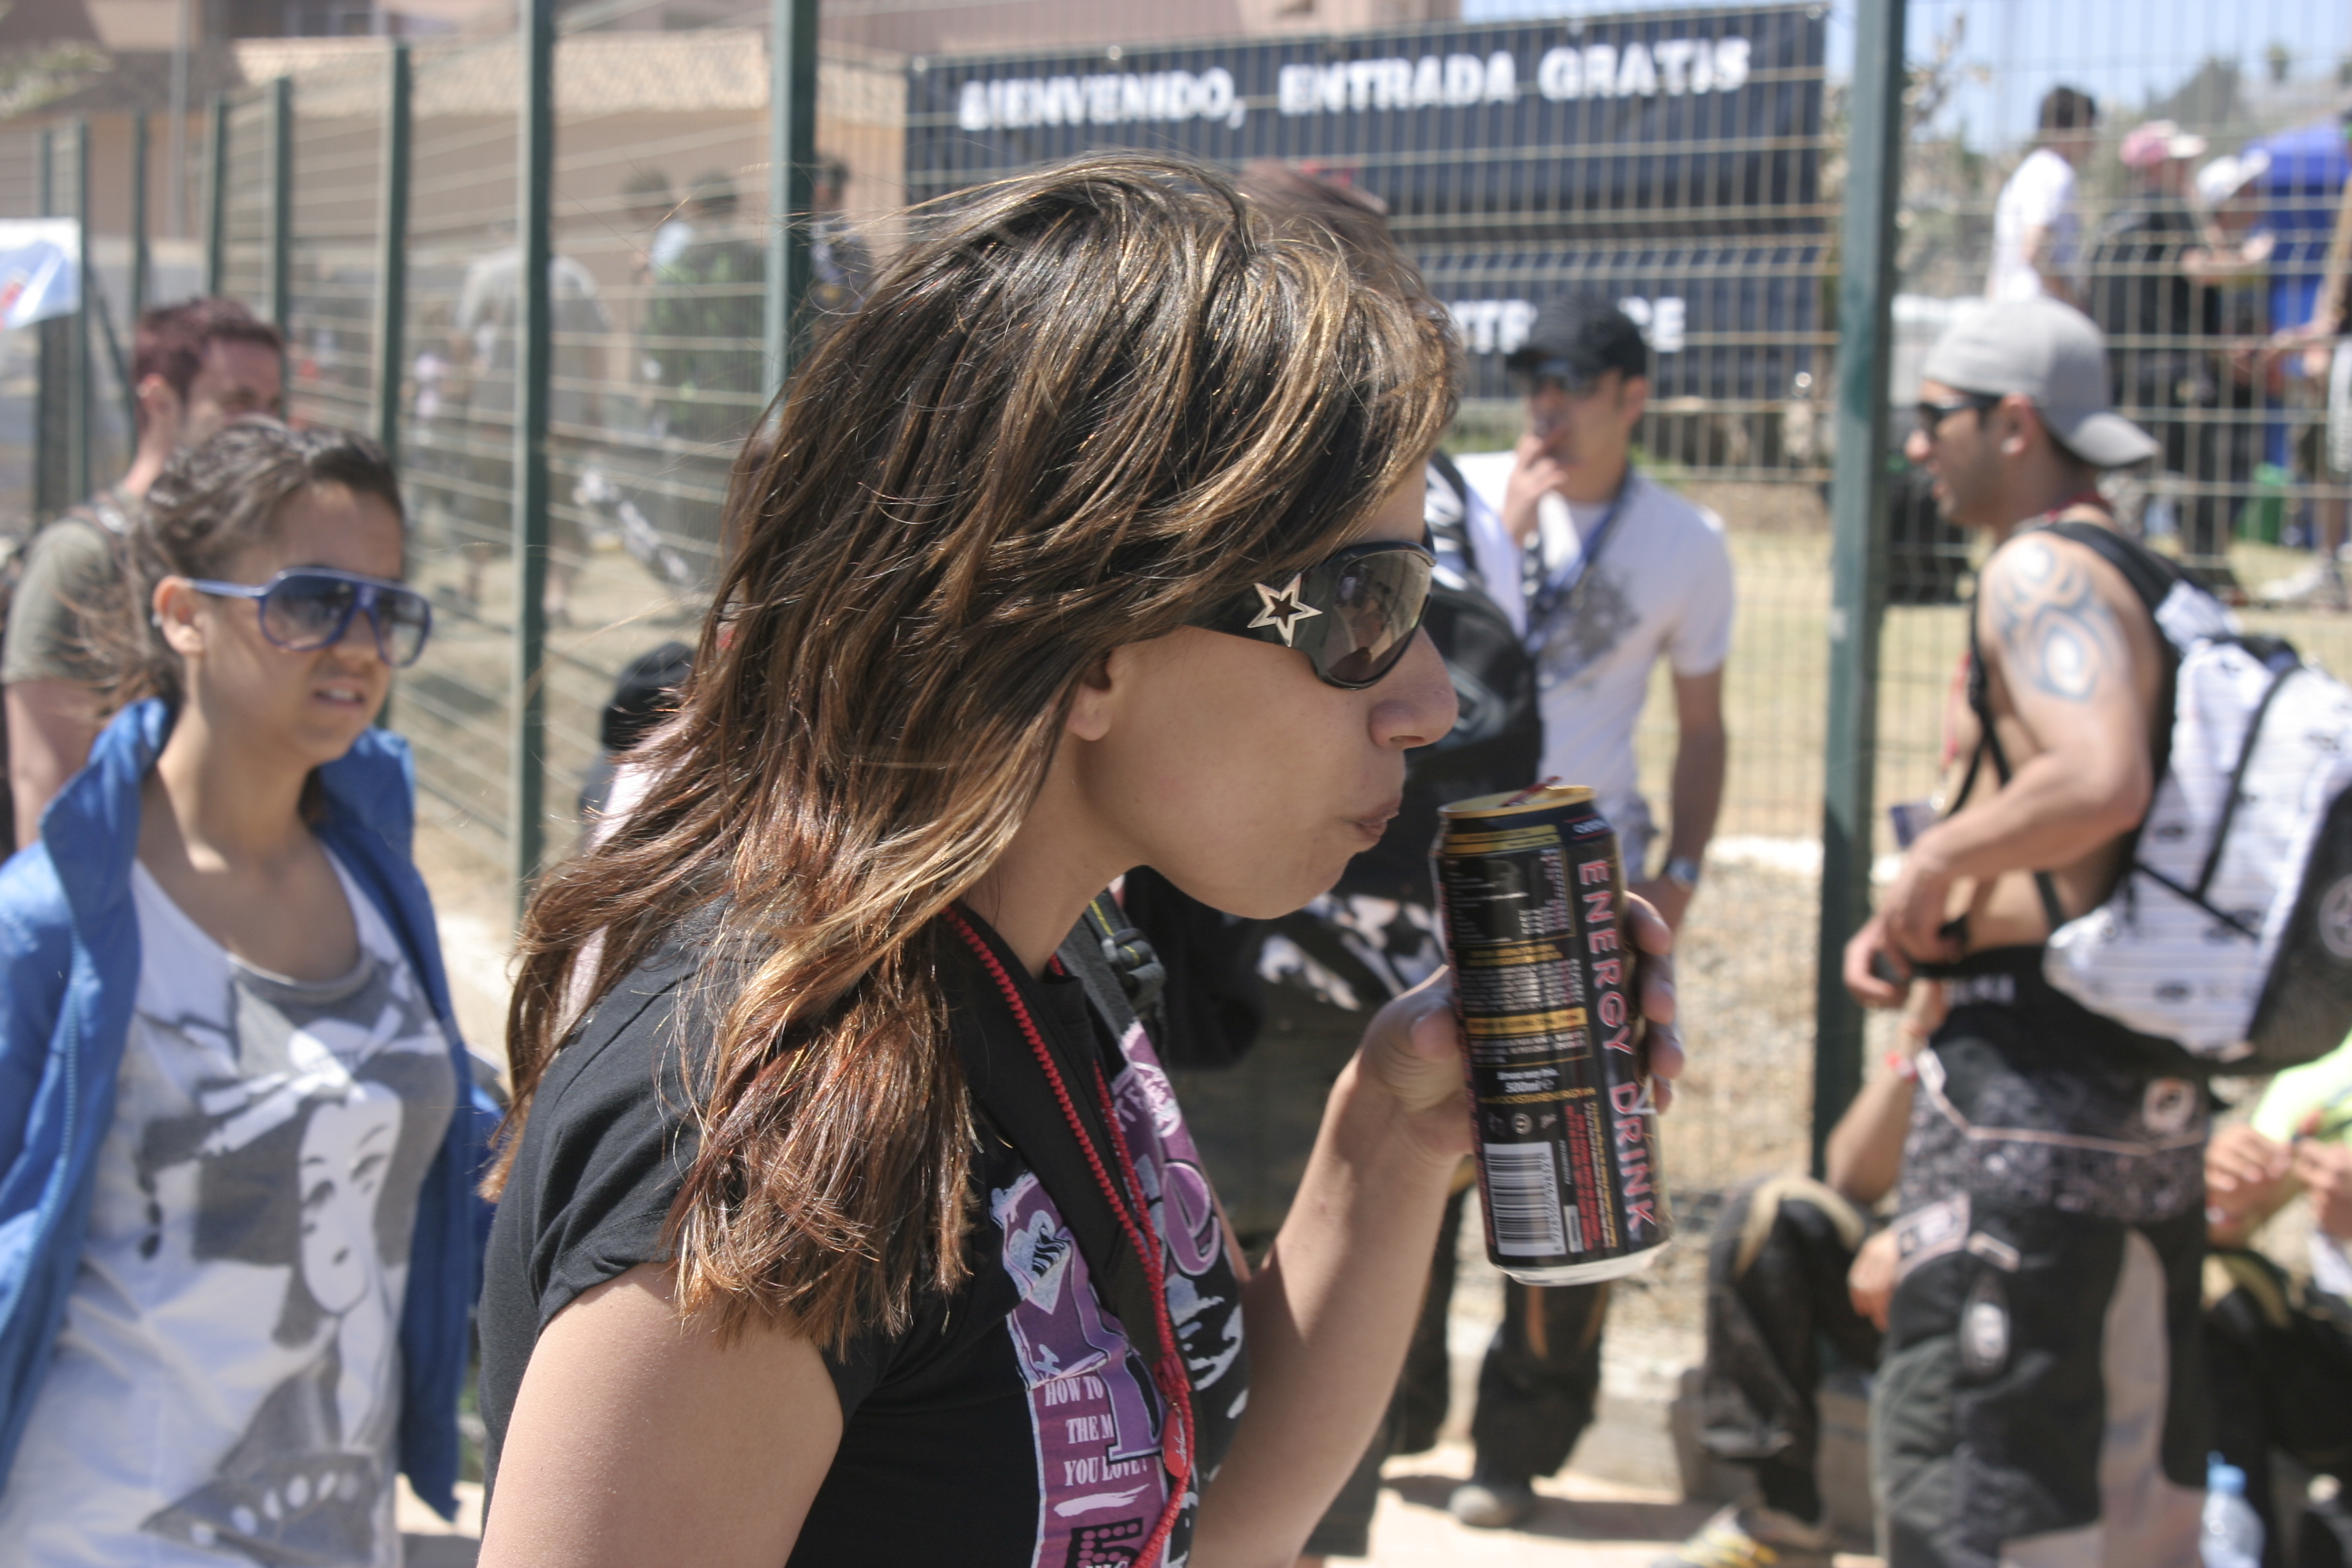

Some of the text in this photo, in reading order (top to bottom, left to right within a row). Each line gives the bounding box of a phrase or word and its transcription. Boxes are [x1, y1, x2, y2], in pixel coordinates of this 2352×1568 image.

[958, 36, 1751, 131] BIENVENIDO, ENTRADA GRATIS
[1578, 859, 1633, 1055] ENERGY
[1609, 1081, 1656, 1232] DRINK
[1045, 1375, 1104, 1407] HOW TO
[1066, 1416, 1100, 1444] THE
[1064, 1456, 1099, 1486] YOU
